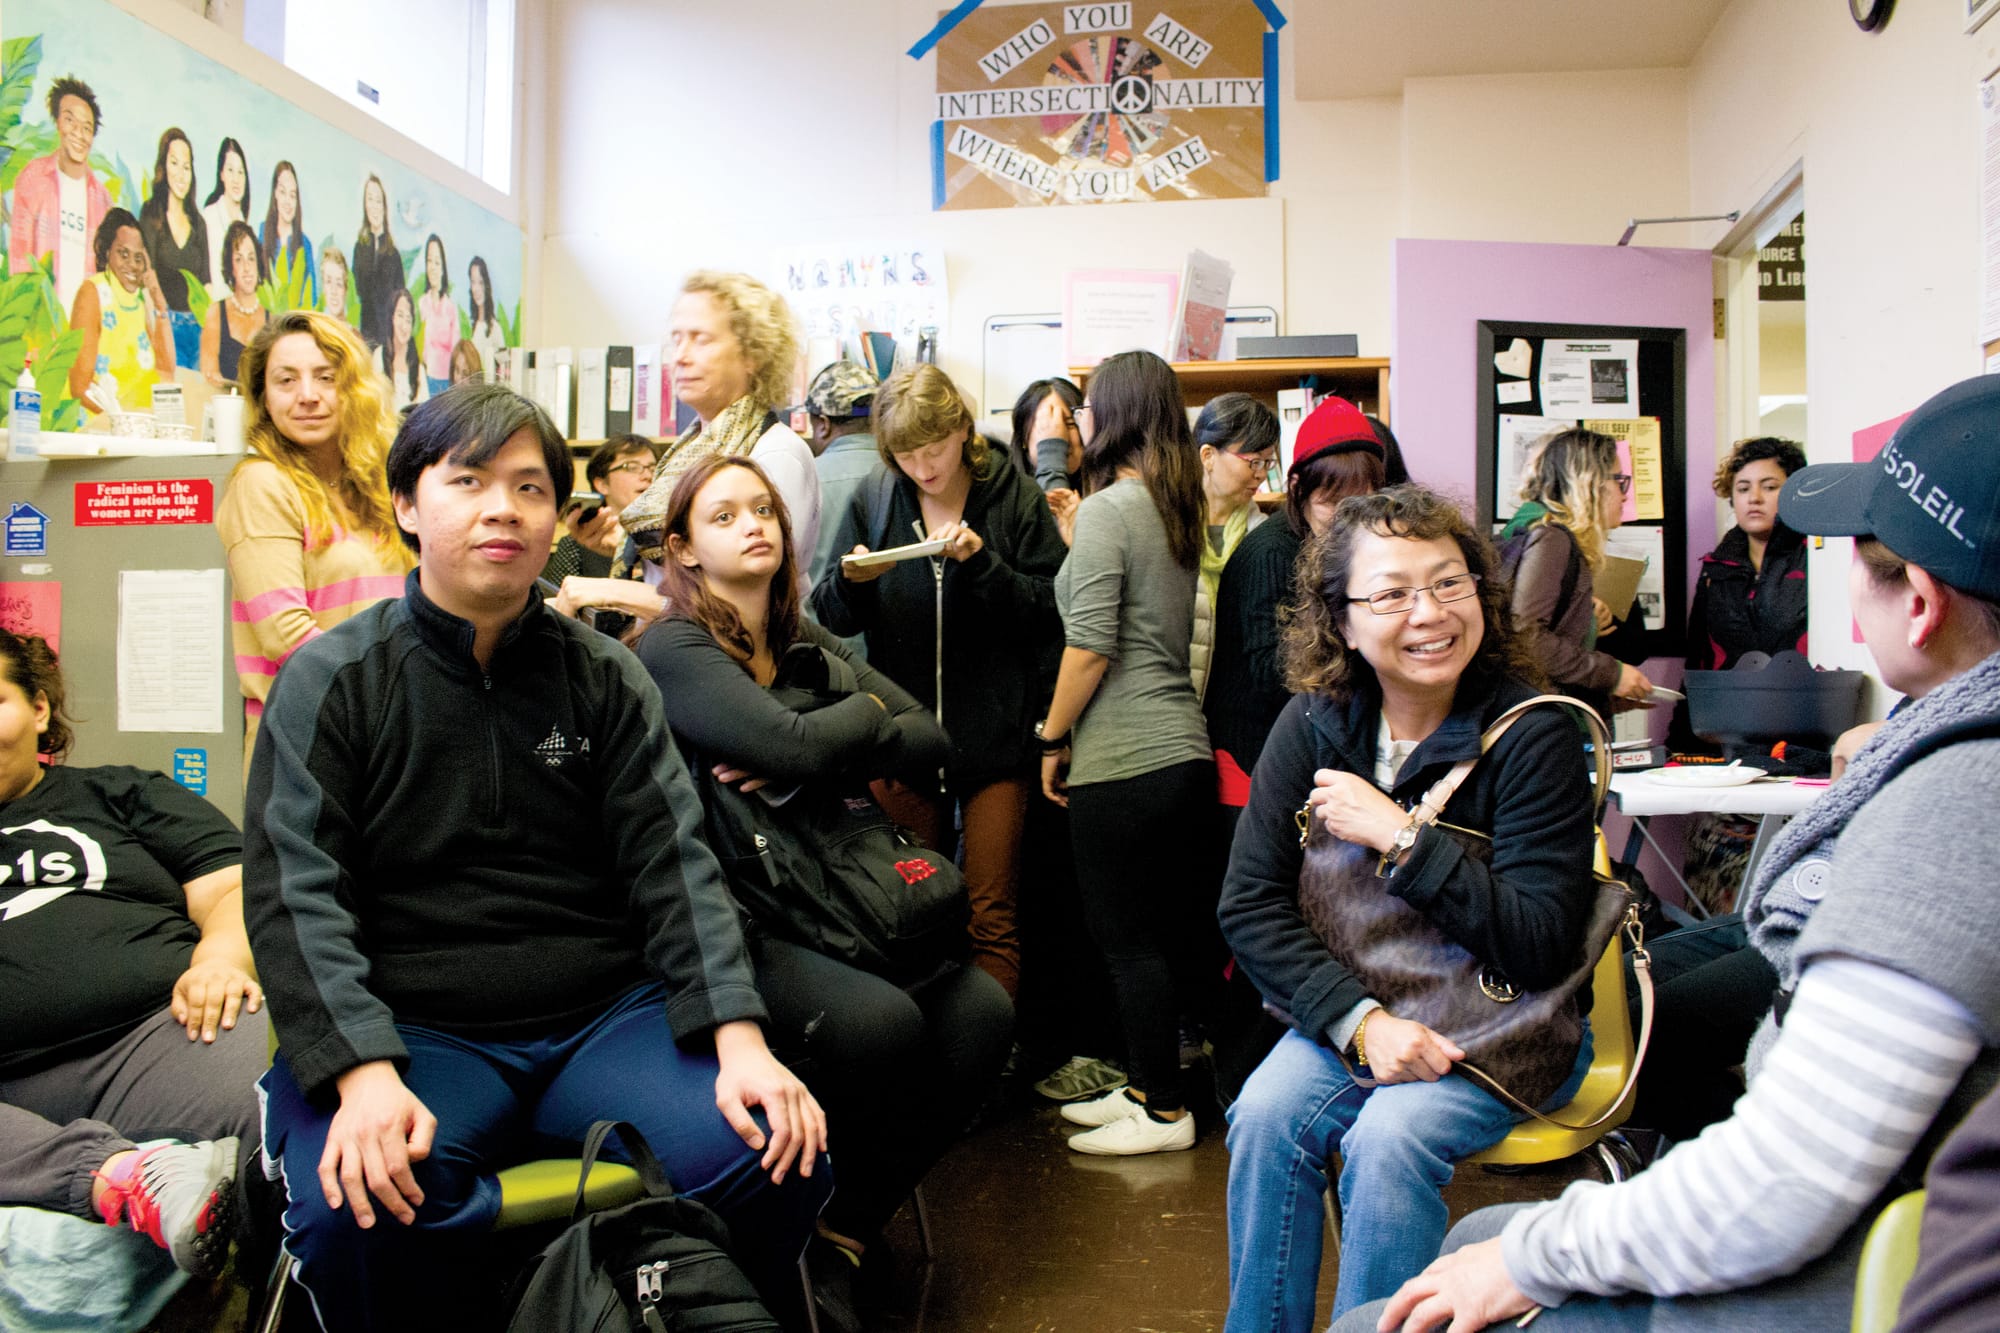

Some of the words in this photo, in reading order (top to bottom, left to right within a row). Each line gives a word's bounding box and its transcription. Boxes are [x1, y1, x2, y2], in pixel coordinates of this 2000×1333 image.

[983, 23, 1051, 74] WHO
[1069, 4, 1128, 30] YOU
[1150, 21, 1208, 65] ARE
[956, 130, 1055, 194] WHERE
[1072, 171, 1130, 196] YOU
[1152, 139, 1208, 187] ARE
[1611, 423, 1630, 433] SELF
[97, 483, 154, 495] Feminism
[157, 482, 167, 494] is
[170, 481, 190, 493] the
[88, 495, 129, 507] radical
[133, 494, 170, 506] notion
[174, 493, 199, 505] that
[90, 509, 130, 518] women
[134, 509, 153, 518] are
[157, 506, 196, 520] people
